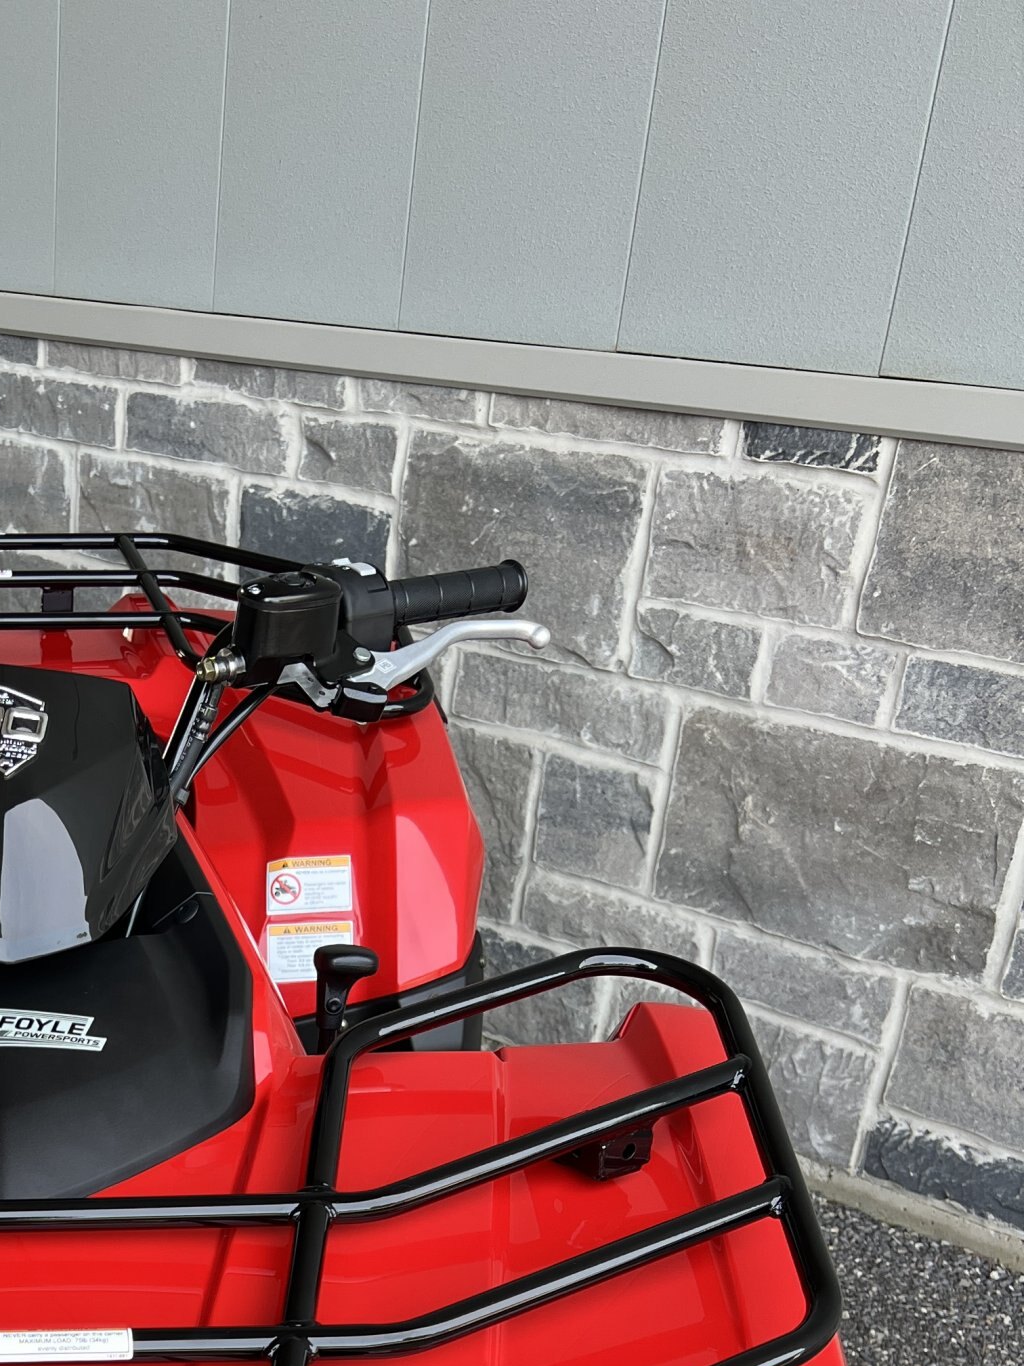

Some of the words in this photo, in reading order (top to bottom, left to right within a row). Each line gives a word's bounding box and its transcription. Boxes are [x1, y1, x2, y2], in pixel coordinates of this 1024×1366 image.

[291, 858, 332, 868] WARNING
[294, 924, 338, 934] WARNING
[13, 1030, 100, 1047] POWERSPORTS
